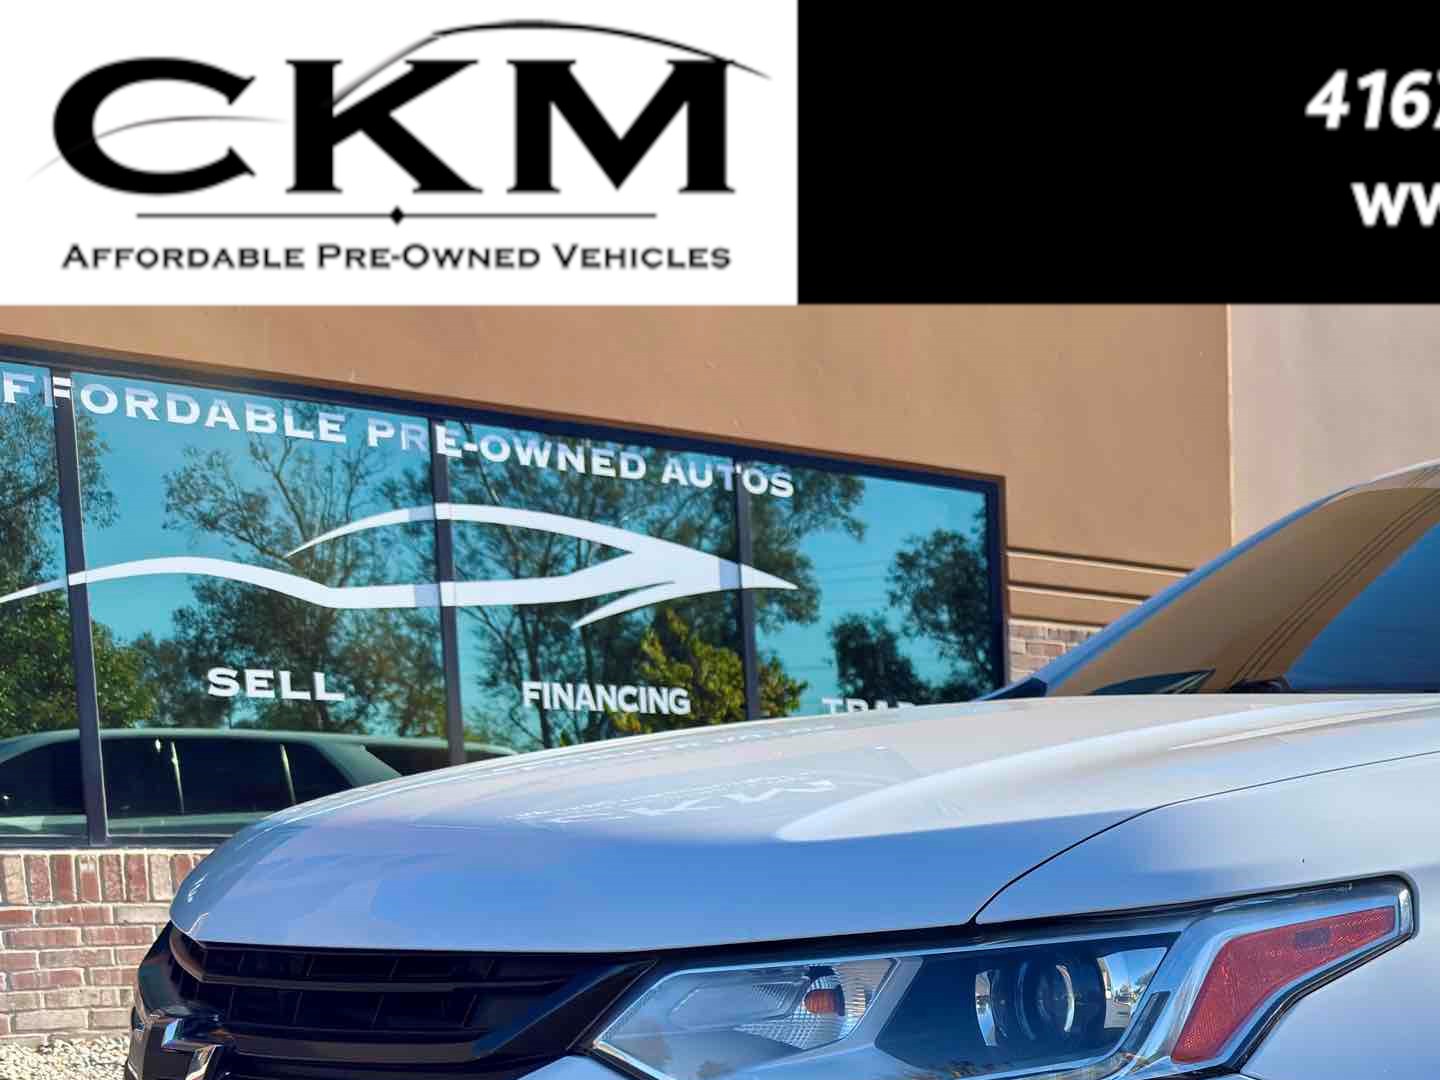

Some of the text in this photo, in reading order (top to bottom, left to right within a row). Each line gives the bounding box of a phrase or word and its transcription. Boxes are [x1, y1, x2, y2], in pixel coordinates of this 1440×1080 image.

[366, 417, 648, 481] PRE-OWNED
[661, 455, 795, 498] AUTOS
[206, 667, 346, 702] SELL
[521, 680, 691, 716] FINANCING
